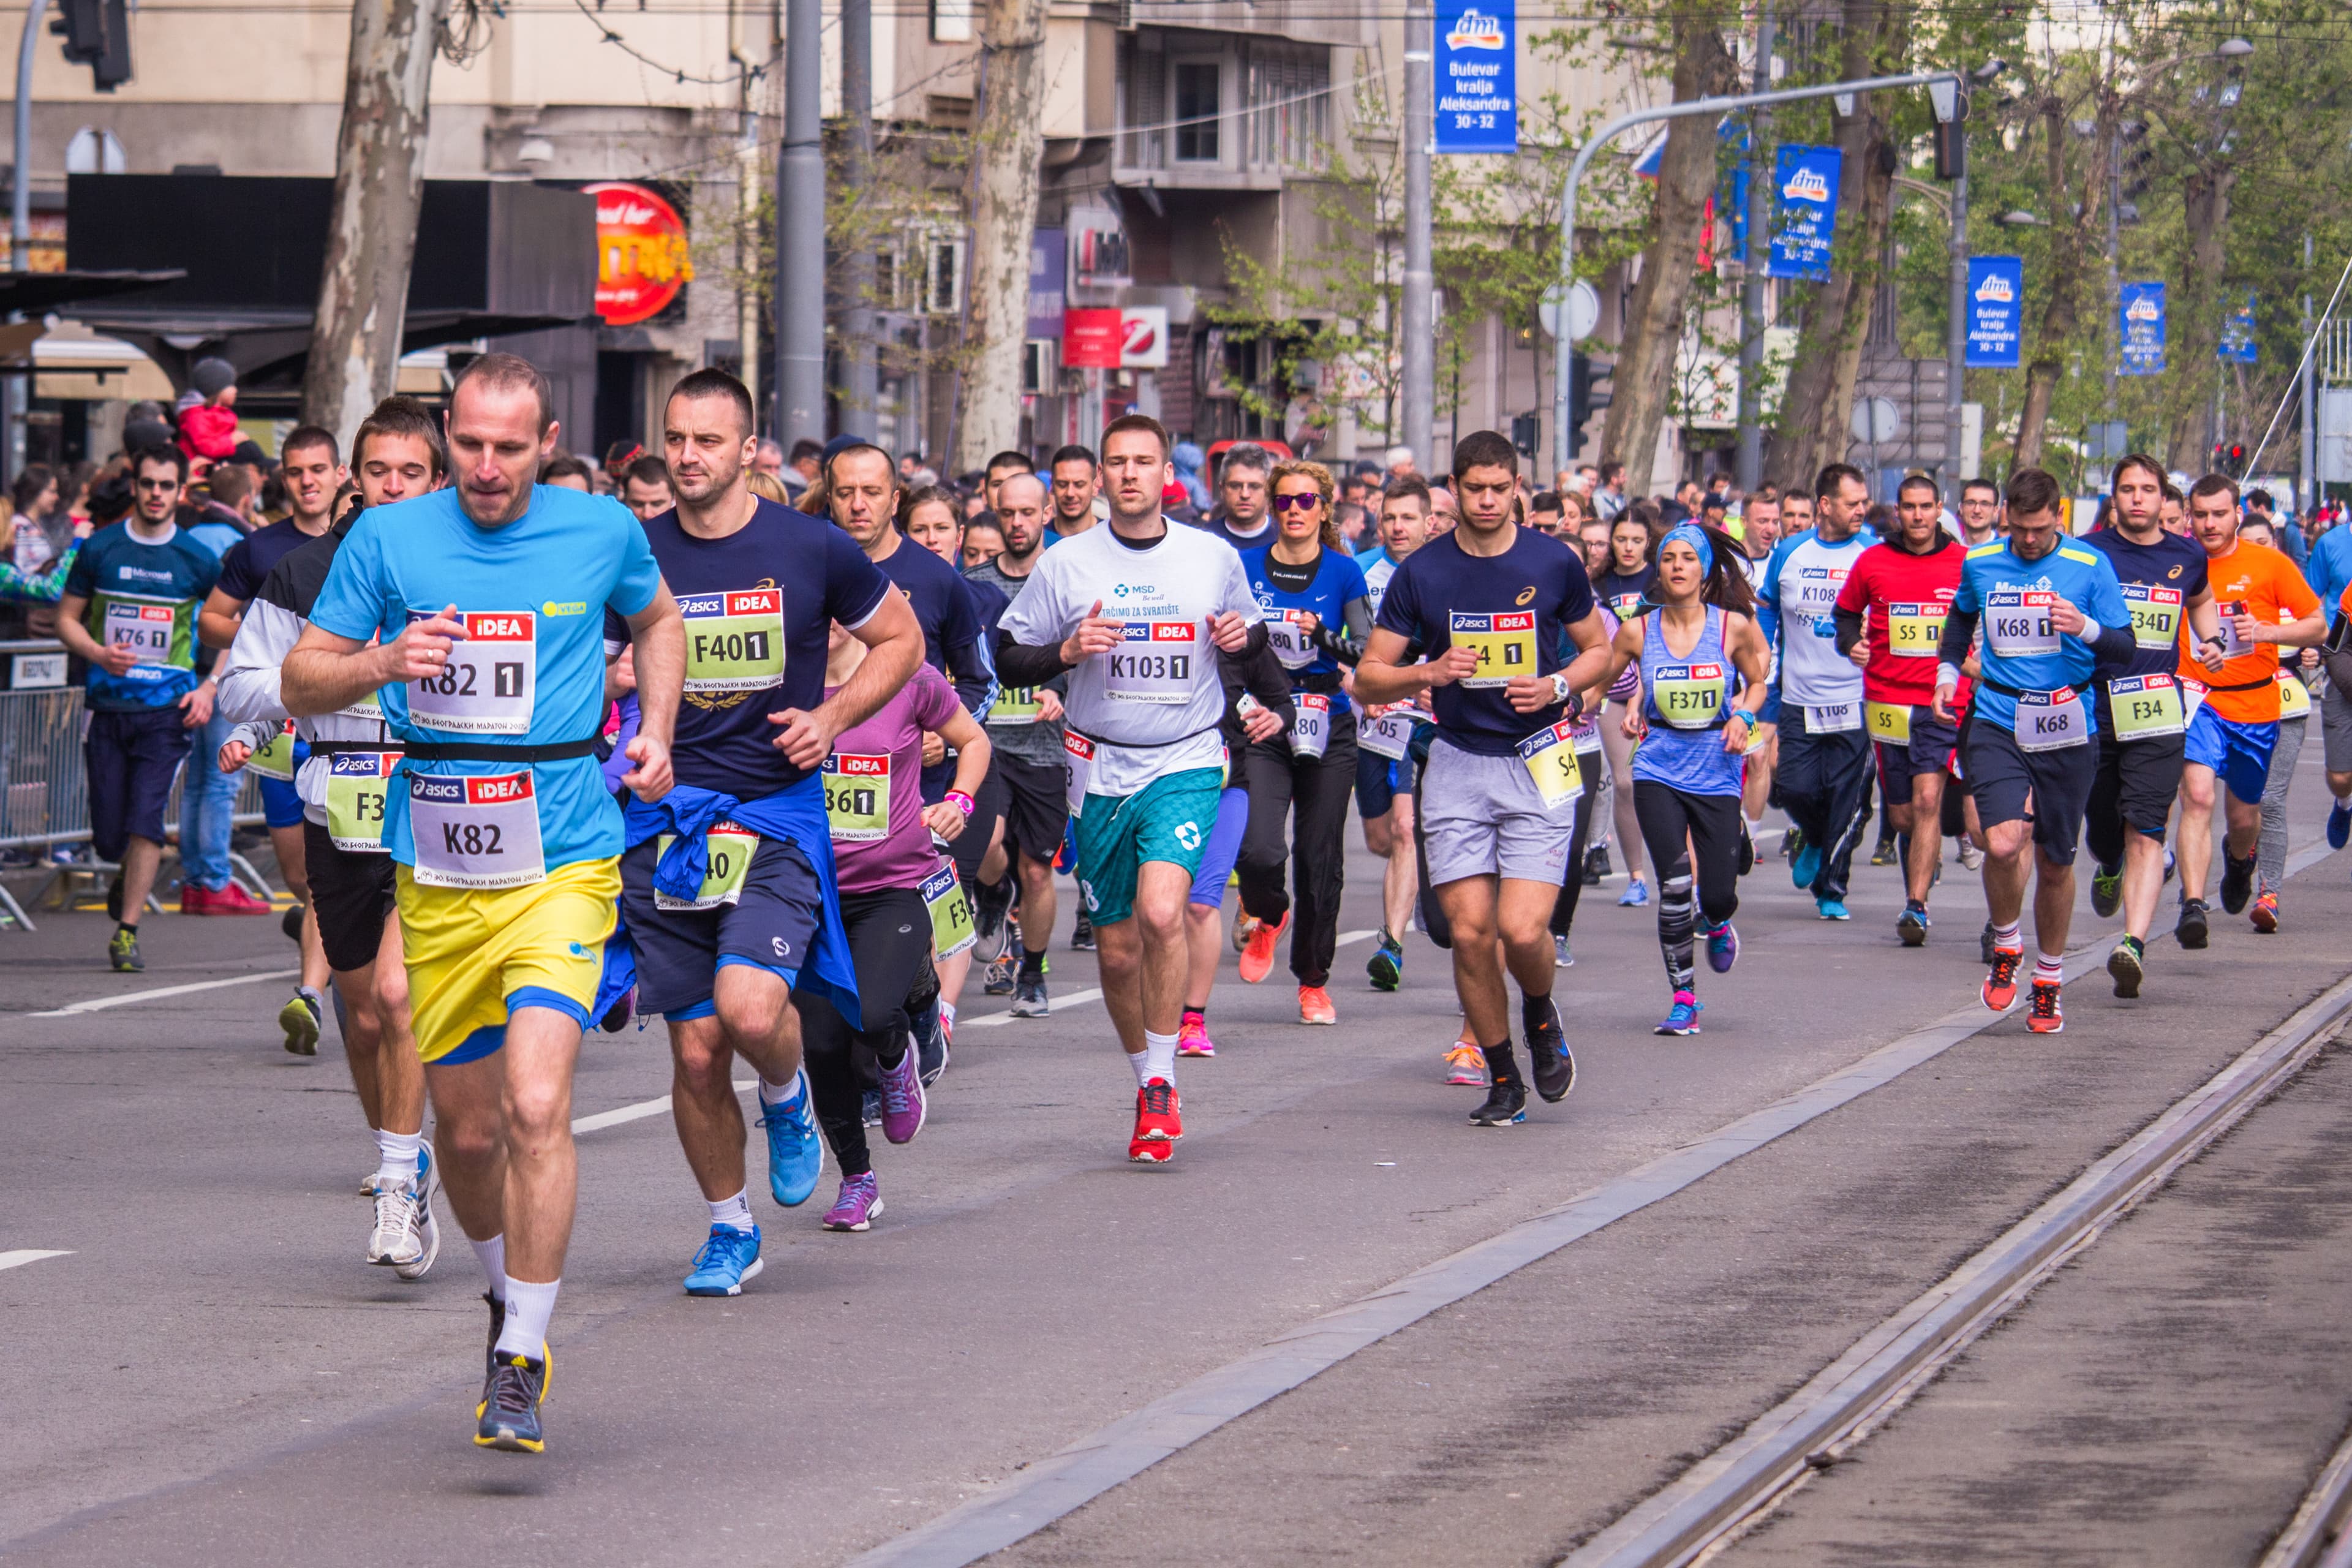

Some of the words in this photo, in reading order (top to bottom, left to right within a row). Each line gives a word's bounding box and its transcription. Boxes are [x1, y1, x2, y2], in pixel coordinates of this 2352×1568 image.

[1455, 9, 1498, 35] dm
[1449, 61, 1500, 77] Bulevar
[1456, 78, 1494, 96] kralja
[1439, 96, 1510, 111] Aleksandra
[1977, 308, 2009, 319] Bulevar
[1980, 320, 2005, 331] kralja
[1969, 331, 2015, 341] Aleksandra
[133, 567, 173, 581] Microsoft
[1273, 571, 1307, 580] hummel
[1802, 587, 1836, 602] K108
[688, 600, 719, 612] asics
[1102, 606, 1129, 618] TRČIMO
[1133, 607, 1140, 616] ZA
[1142, 603, 1180, 616] SVRATIŠTE
[1900, 625, 1916, 640] S5
[1997, 618, 2029, 637] K68
[115, 627, 145, 646] K76
[1268, 633, 1291, 650] 80
[1110, 655, 1165, 679] K103
[997, 688, 1015, 704] 41
[2133, 699, 2163, 720] F34
[432, 719, 473, 729] БЕОГРАДСКИ
[1879, 712, 1892, 728] S5
[2035, 714, 2068, 734] K68
[349, 760, 374, 771] asics
[1558, 753, 1577, 777] S4
[426, 784, 459, 797] asics
[826, 788, 851, 813] 36
[442, 822, 503, 855] K82
[706, 852, 729, 880] 40
[446, 875, 486, 886] БЕОГРАДСКИ
[489, 876, 521, 886] МАРАТОН
[933, 873, 952, 892] asics
